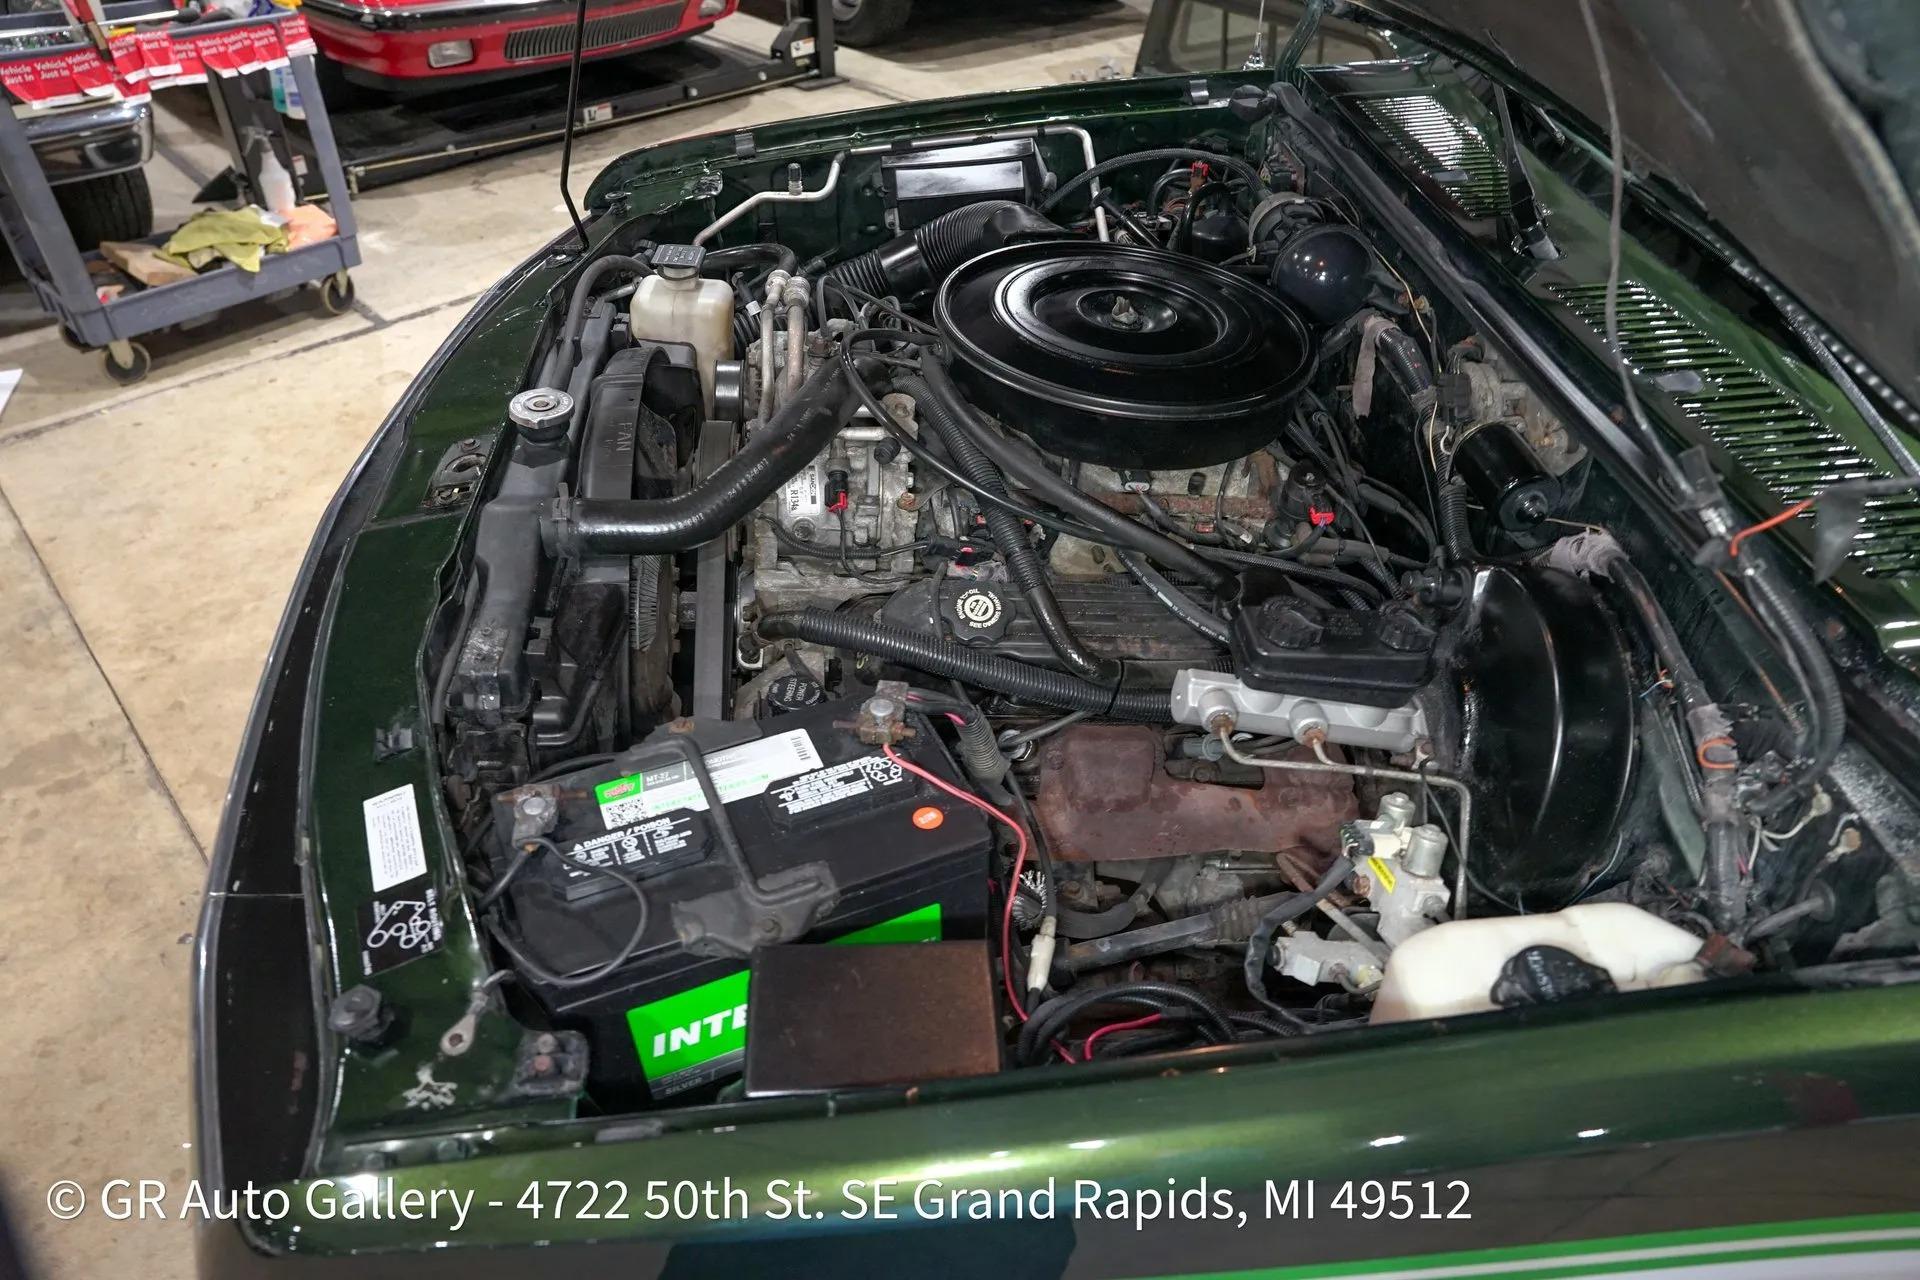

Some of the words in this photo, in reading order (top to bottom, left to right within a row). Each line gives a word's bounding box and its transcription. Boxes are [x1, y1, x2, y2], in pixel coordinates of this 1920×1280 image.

[34, 60, 68, 72] Vehicle
[40, 69, 59, 80] Just
[783, 677, 798, 702] STEERING
[796, 682, 808, 702] POWER
[583, 830, 626, 849] DANGER
[633, 816, 672, 834] POISON
